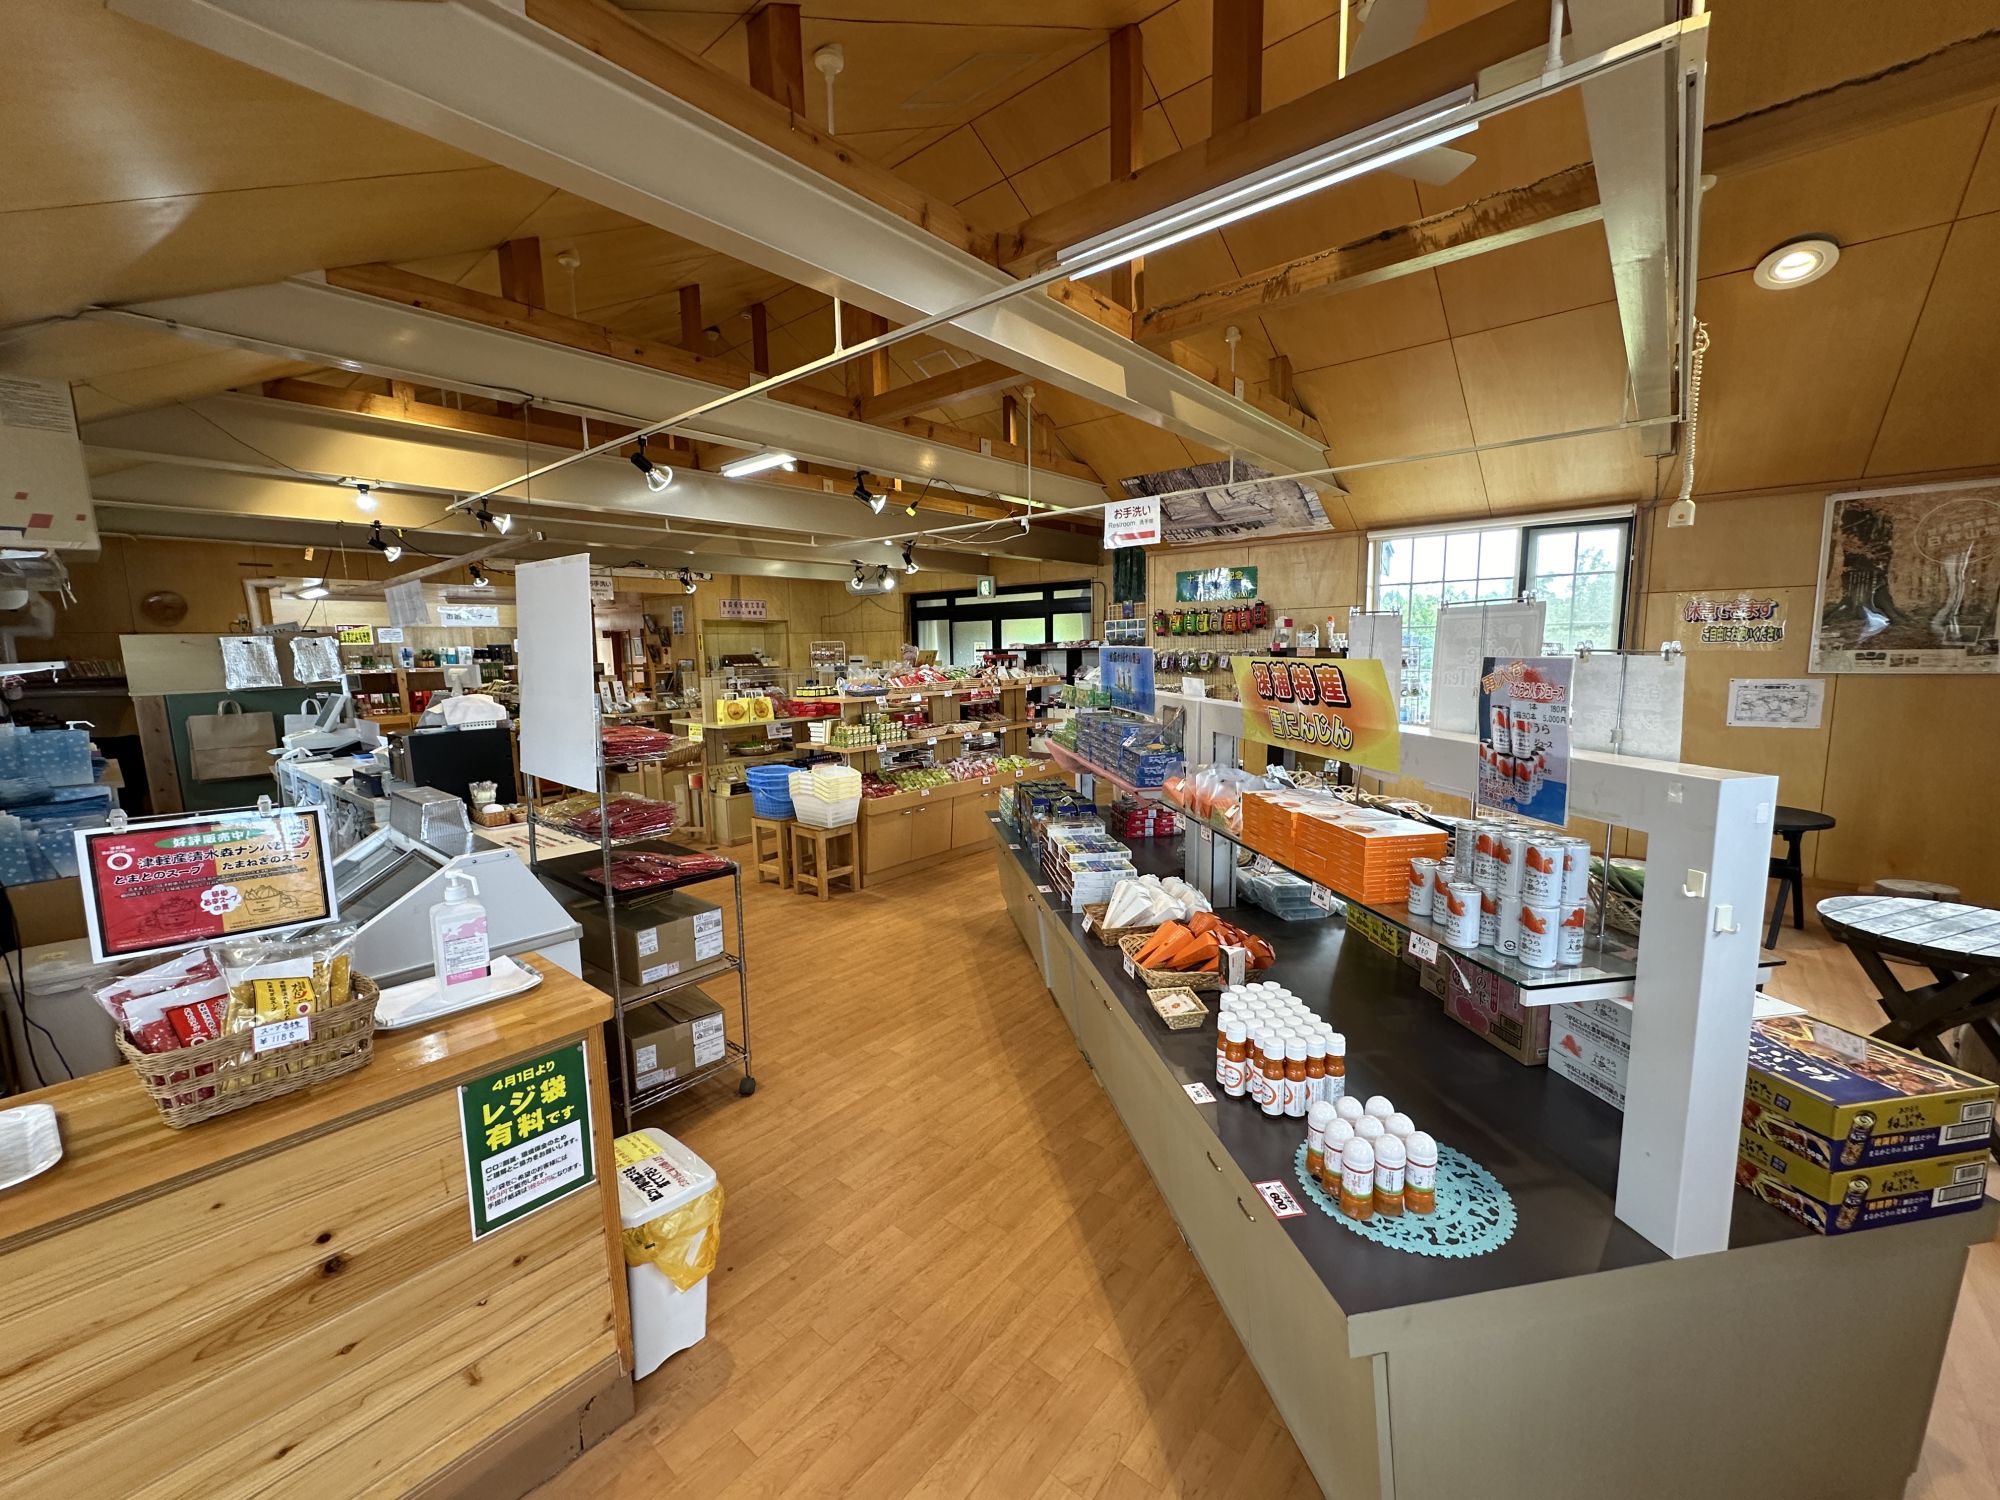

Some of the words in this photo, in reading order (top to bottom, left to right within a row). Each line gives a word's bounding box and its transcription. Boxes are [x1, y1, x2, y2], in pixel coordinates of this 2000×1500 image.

[1114, 505, 1151, 520] お手洗い
[1684, 599, 1778, 622] 休憩できます
[1251, 660, 1351, 707] 深浦特産
[1481, 660, 1525, 695] 再入荷
[1550, 704, 1567, 713] 180円
[1268, 706, 1352, 749] 雪にんじん
[138, 841, 282, 869] 津軽産清水森ナンバと
[222, 850, 311, 871] たまねぎのスープ
[113, 863, 205, 886] とまとのスープ
[1418, 945, 1429, 955] 180
[272, 1031, 295, 1042] 1188
[491, 1060, 555, 1092] 4月1日より
[482, 1074, 567, 1126] レジ袋
[485, 1105, 575, 1151] 有料です
[485, 1153, 568, 1195] レジ袋をご希望のお客様には
[1269, 1191, 1288, 1210] 600
